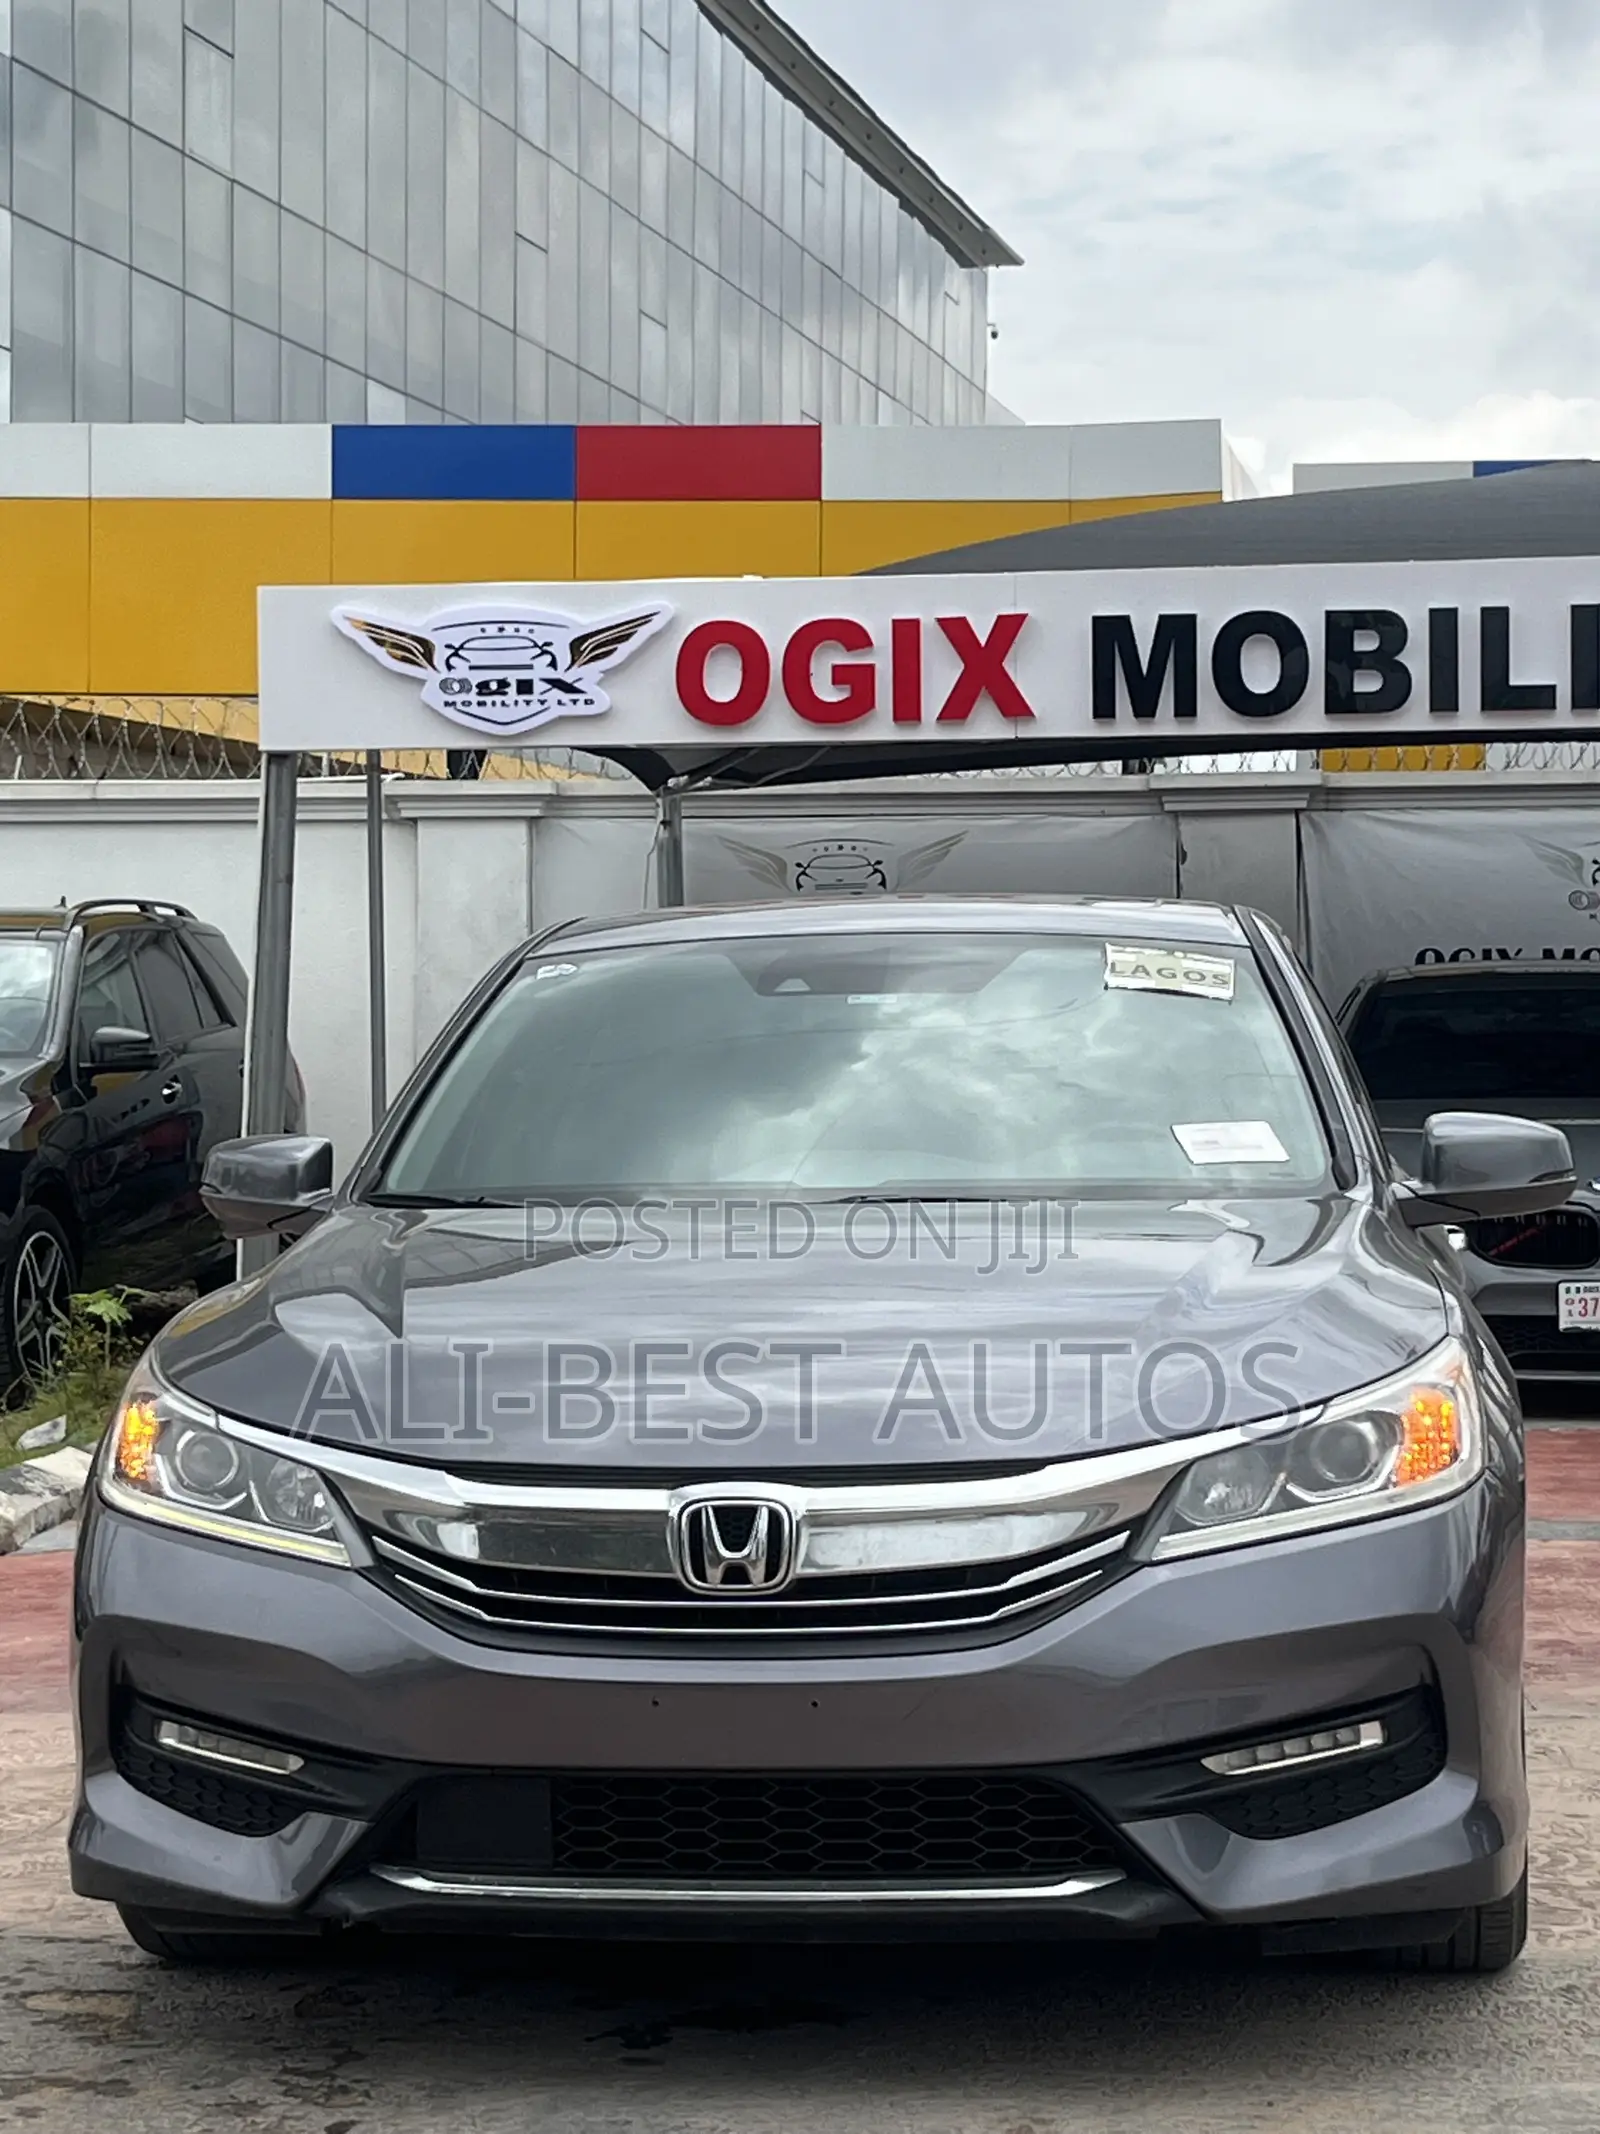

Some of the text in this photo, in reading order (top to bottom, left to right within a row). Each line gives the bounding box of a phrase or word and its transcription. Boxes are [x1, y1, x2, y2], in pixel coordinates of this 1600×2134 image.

[676, 604, 1600, 727] OGIX MOBILI
[443, 698, 596, 708] MOBILITY LTD
[1109, 960, 1229, 986] LAGOS
